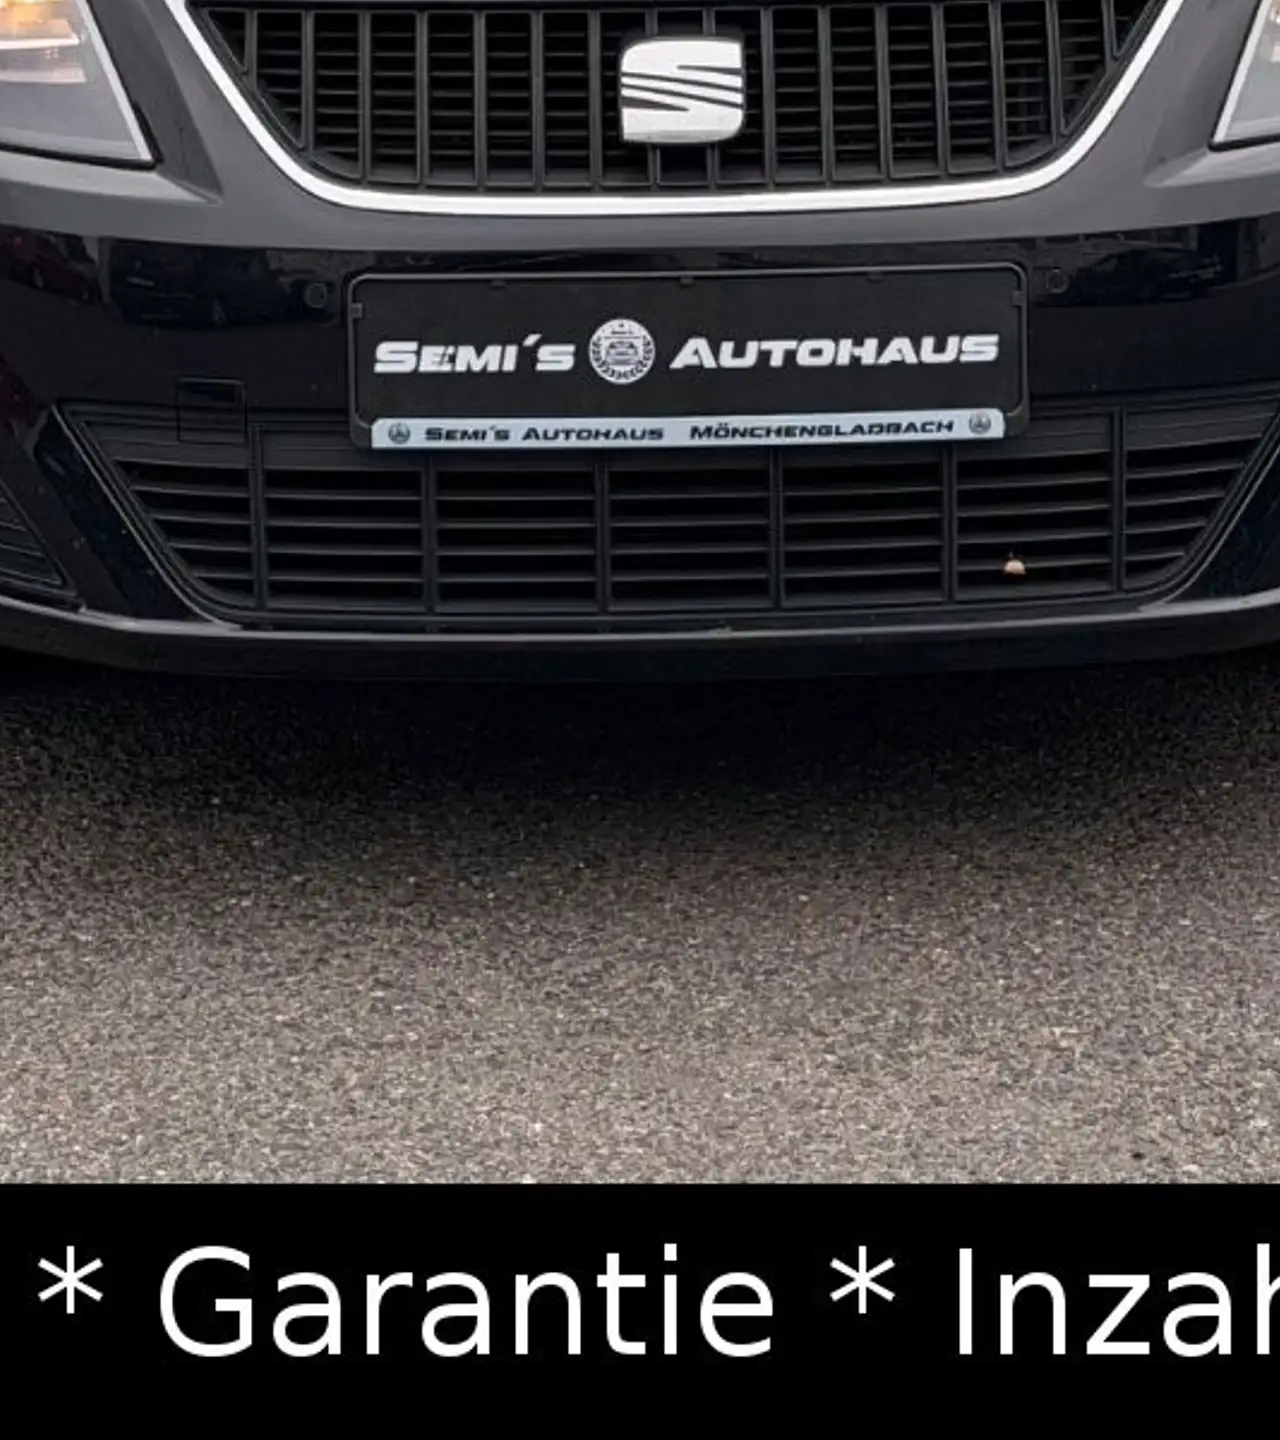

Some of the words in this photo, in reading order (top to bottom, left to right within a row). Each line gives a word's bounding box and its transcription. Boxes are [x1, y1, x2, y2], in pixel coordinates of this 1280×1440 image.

[669, 334, 1000, 370] AUTOHAUS
[521, 426, 665, 442] AUTOHAUS
[689, 420, 955, 441] MÖNCHENGLADBACH
